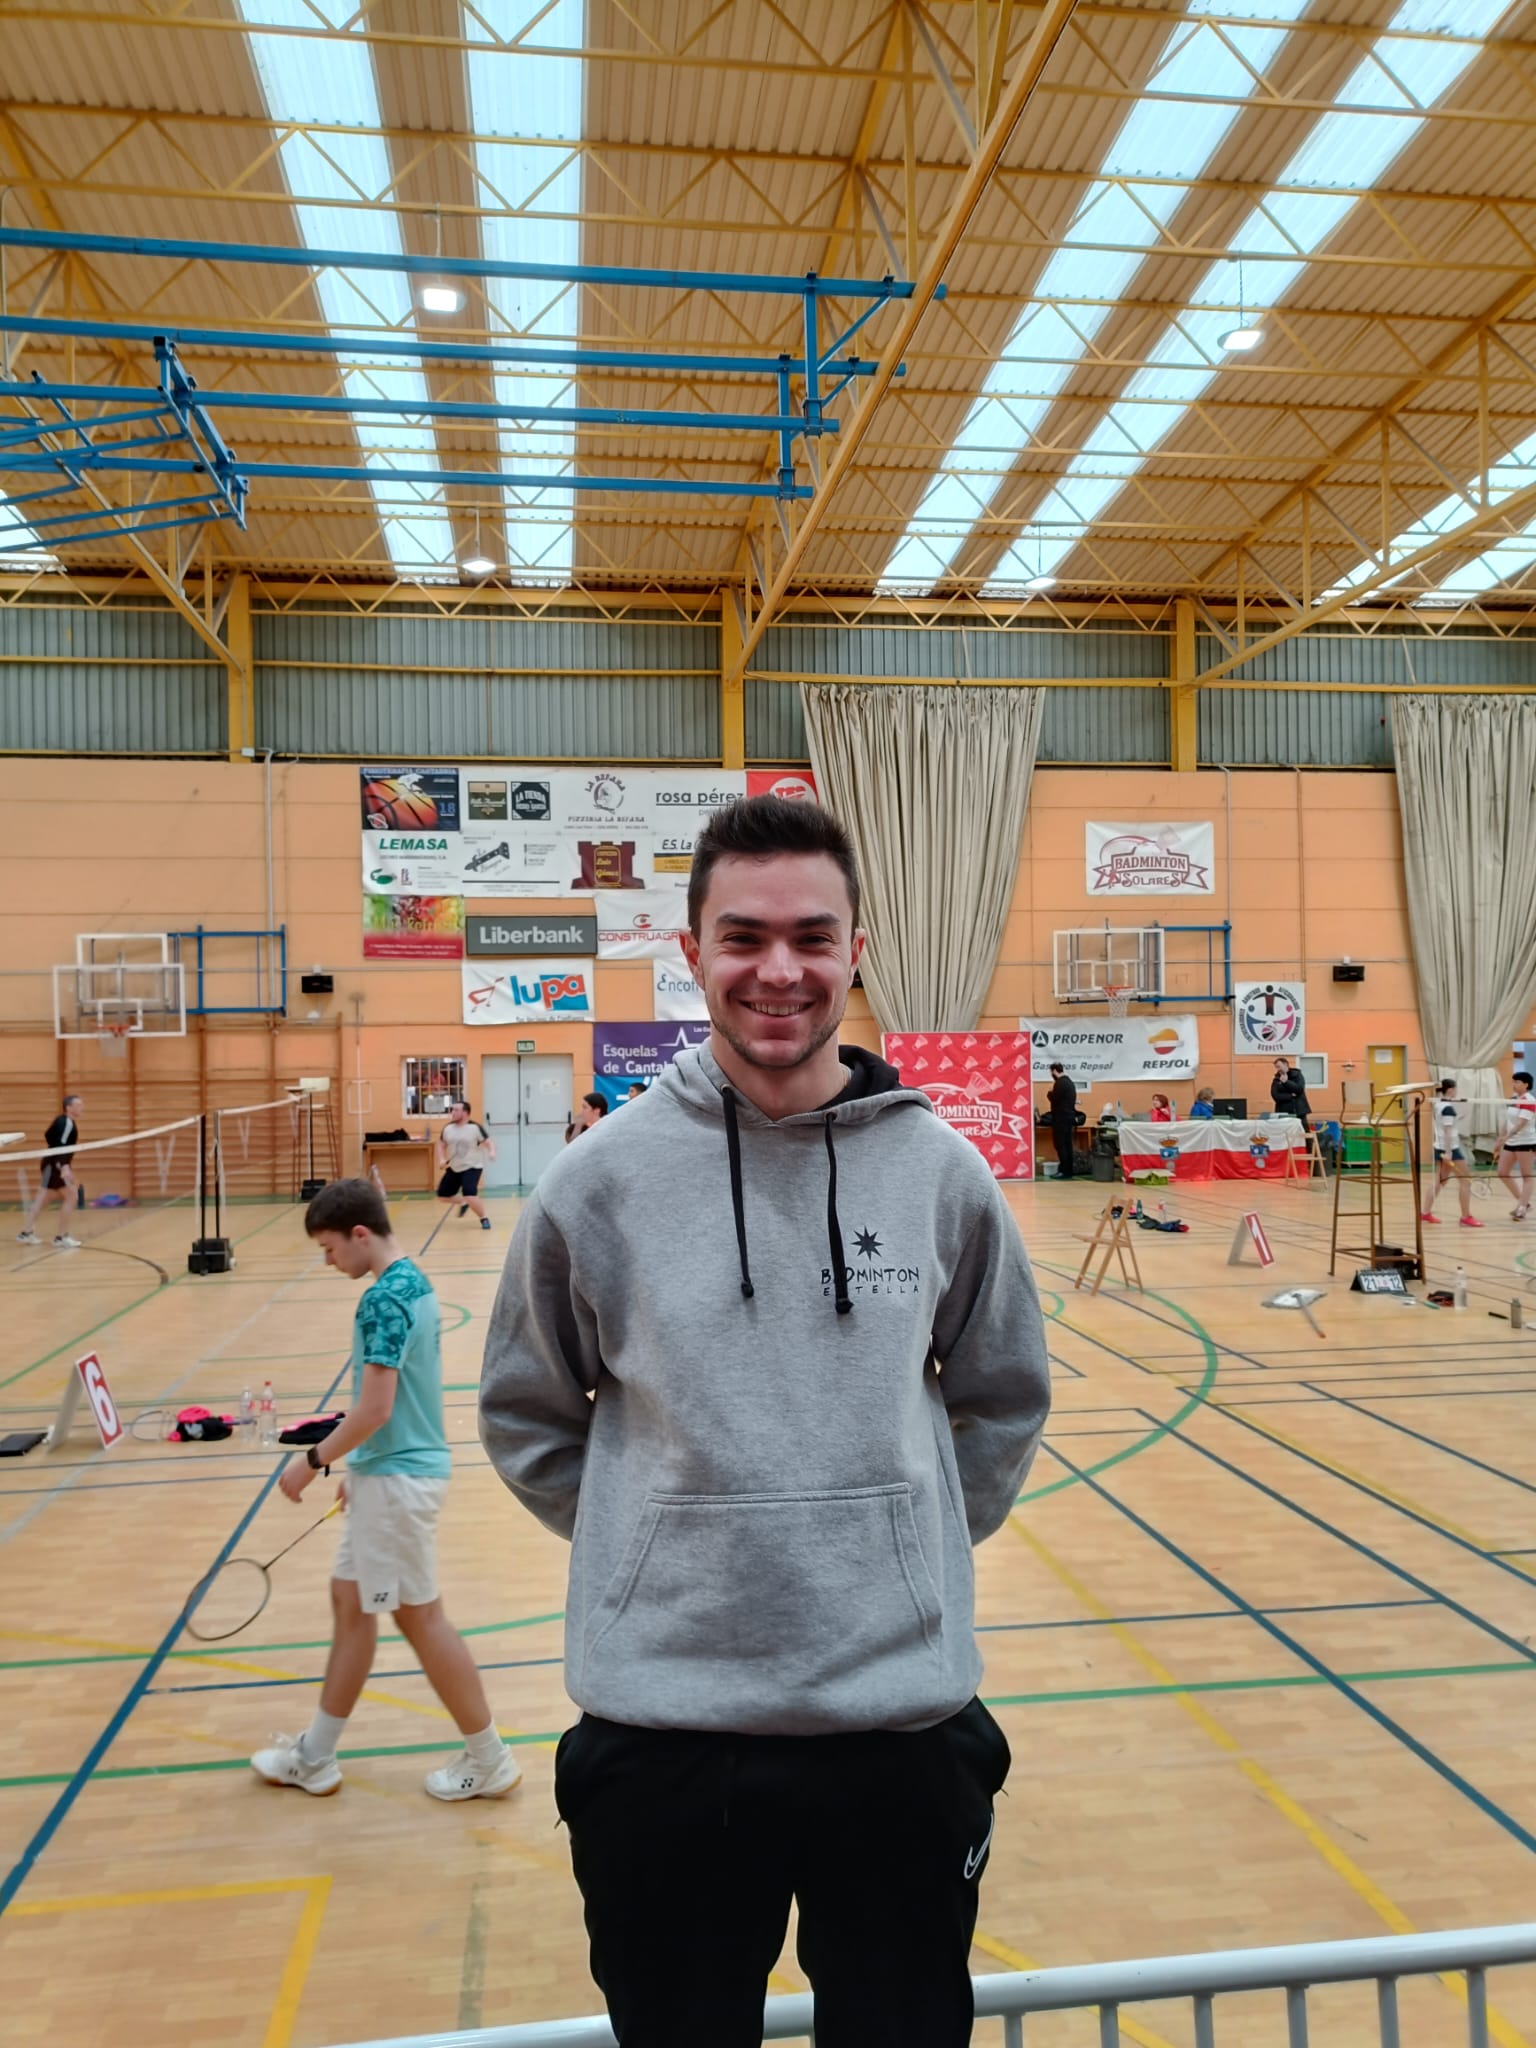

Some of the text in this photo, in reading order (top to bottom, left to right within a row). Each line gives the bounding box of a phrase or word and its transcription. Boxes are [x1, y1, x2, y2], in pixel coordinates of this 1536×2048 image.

[656, 792, 692, 803] rosa
[440, 802, 456, 813] 18
[378, 838, 448, 850] LEMASA
[681, 839, 692, 849] La
[1115, 856, 1186, 870] BADMINTON
[479, 926, 584, 944] Liberbank
[510, 974, 585, 1011] lupa
[1052, 1034, 1124, 1045] PROPENOR
[603, 1044, 658, 1060] Esquelas
[603, 1061, 620, 1074] de
[1080, 1061, 1114, 1072] Repsol
[1142, 1059, 1191, 1070] REPSOL
[936, 1105, 998, 1119] DMINTON
[957, 1122, 992, 1138] ARES
[821, 1266, 920, 1285] BDMINTON
[823, 1284, 919, 1297] ETELLA
[84, 1359, 118, 1437] 6
